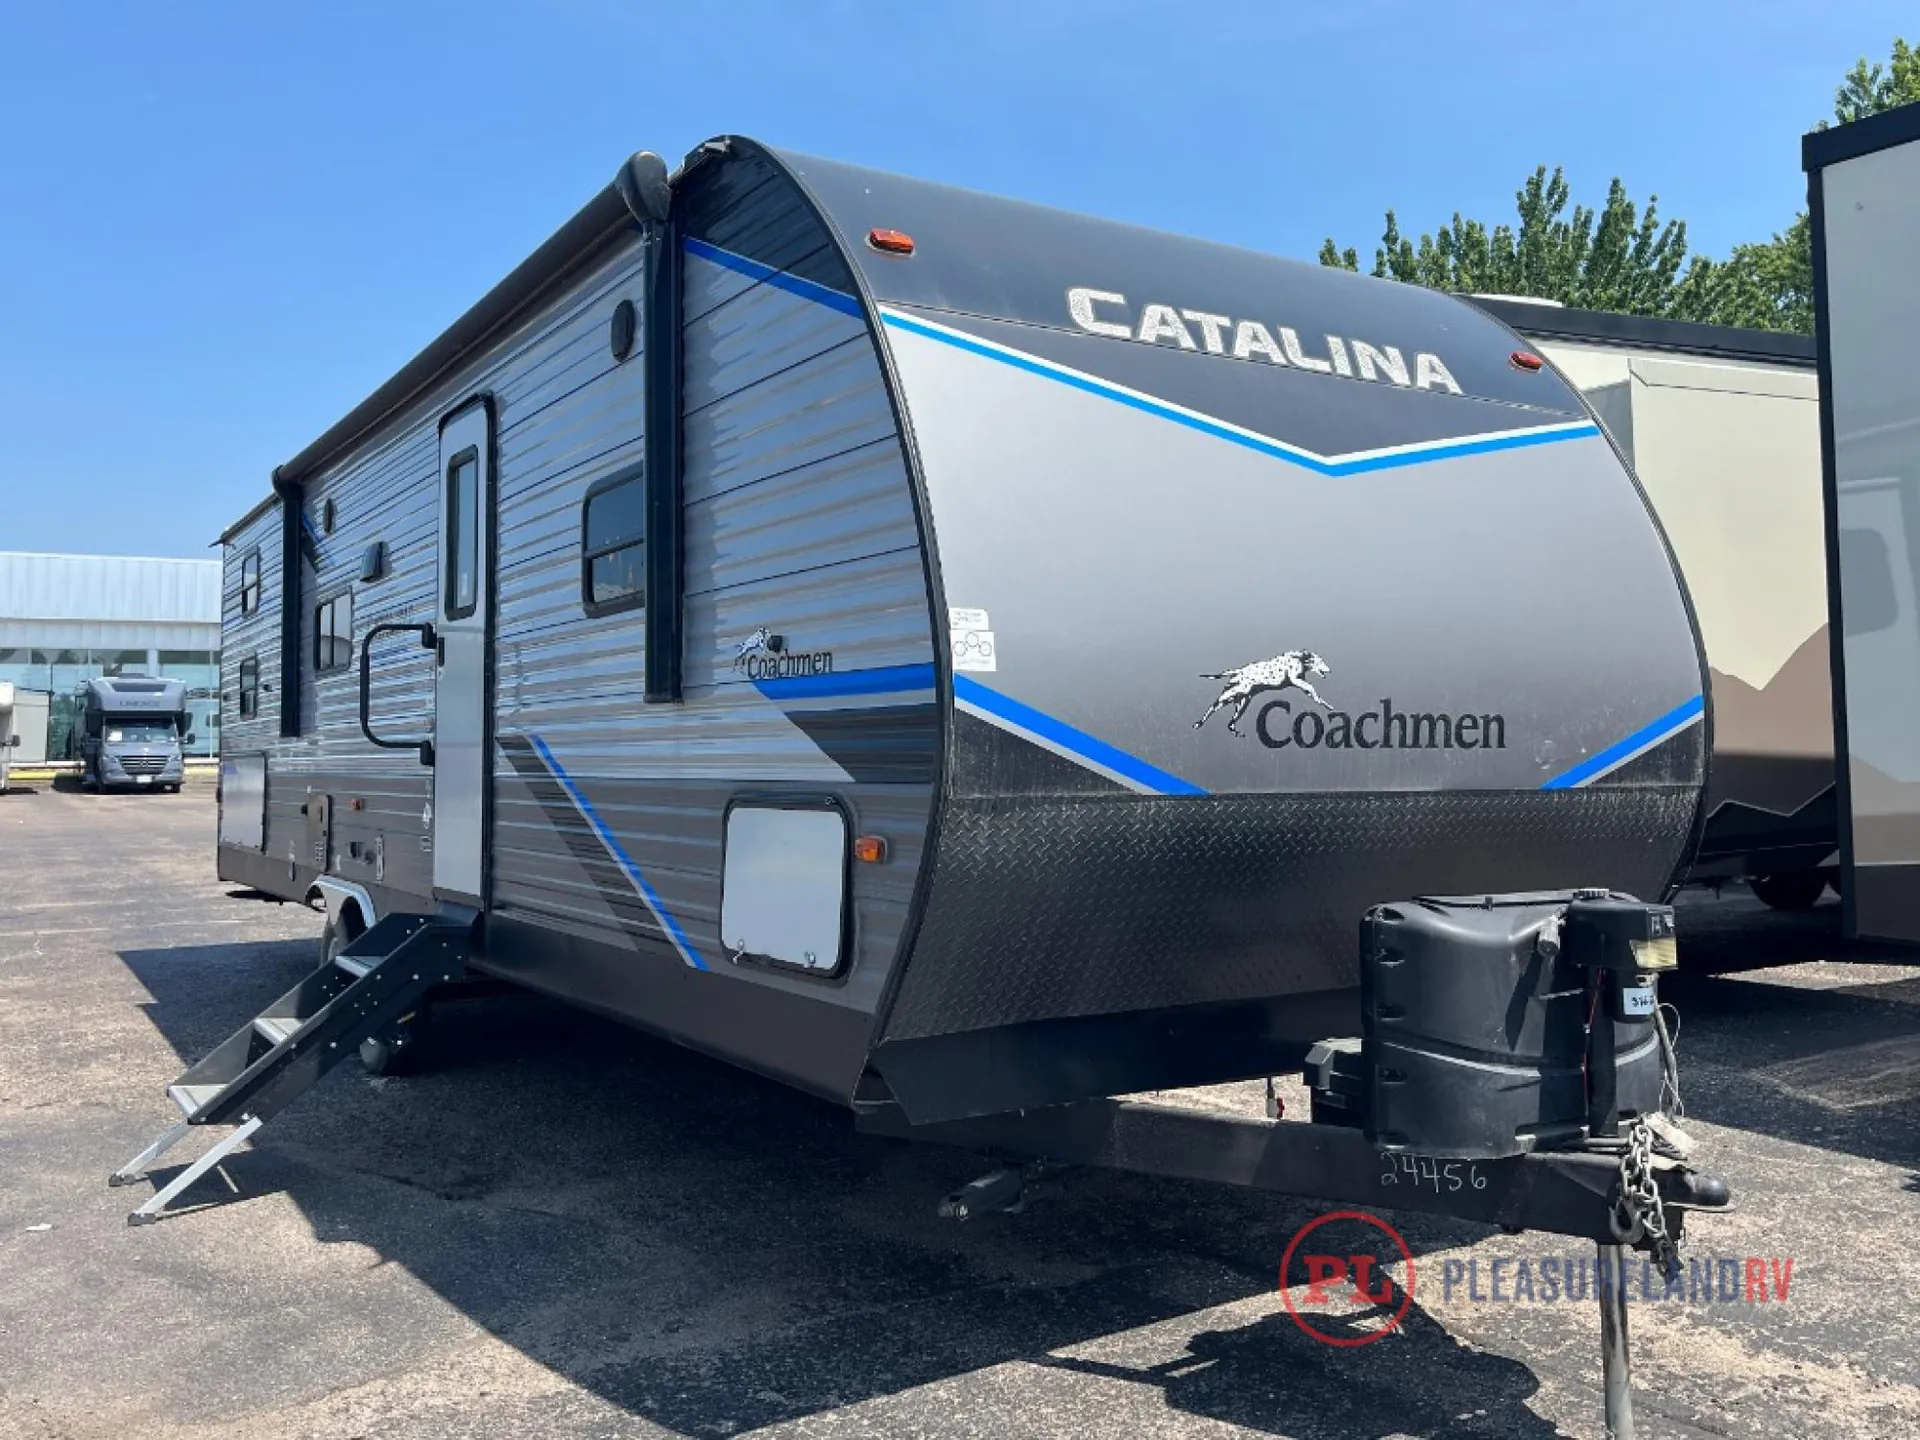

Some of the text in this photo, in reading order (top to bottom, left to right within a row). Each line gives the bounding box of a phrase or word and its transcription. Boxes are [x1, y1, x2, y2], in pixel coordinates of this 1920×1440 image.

[1066, 287, 1464, 395] CATALINA
[747, 648, 833, 679] Coachmen
[1256, 698, 1506, 749] Coachmen
[1381, 1151, 1487, 1193] 24456
